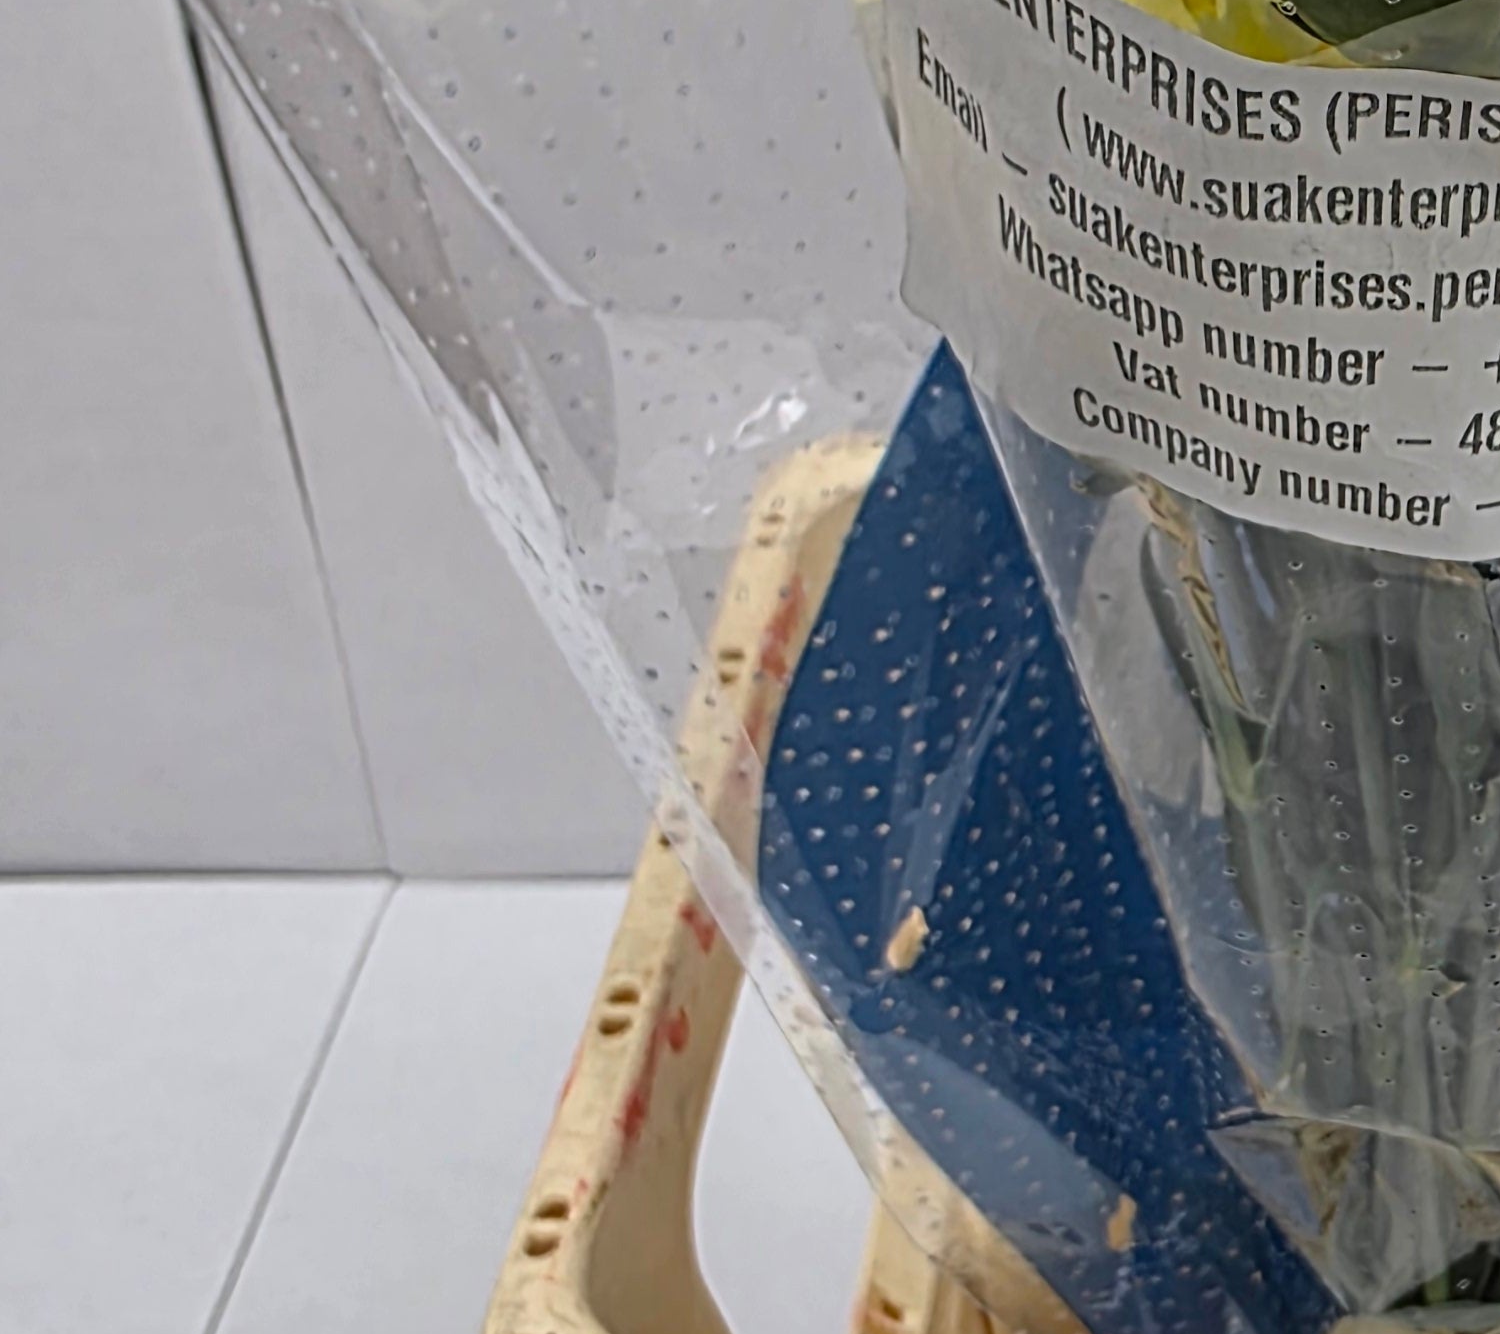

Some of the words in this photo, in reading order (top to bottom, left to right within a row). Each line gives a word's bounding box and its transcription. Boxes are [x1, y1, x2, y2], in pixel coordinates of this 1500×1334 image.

[916, 27, 988, 154] Email
[999, 194, 1185, 348] Whatsapp
[1203, 321, 1386, 386] number
[1073, 387, 1261, 497] Company
[1279, 467, 1451, 527] number
[1112, 341, 1182, 400] Vat
[1200, 380, 1370, 454] number
